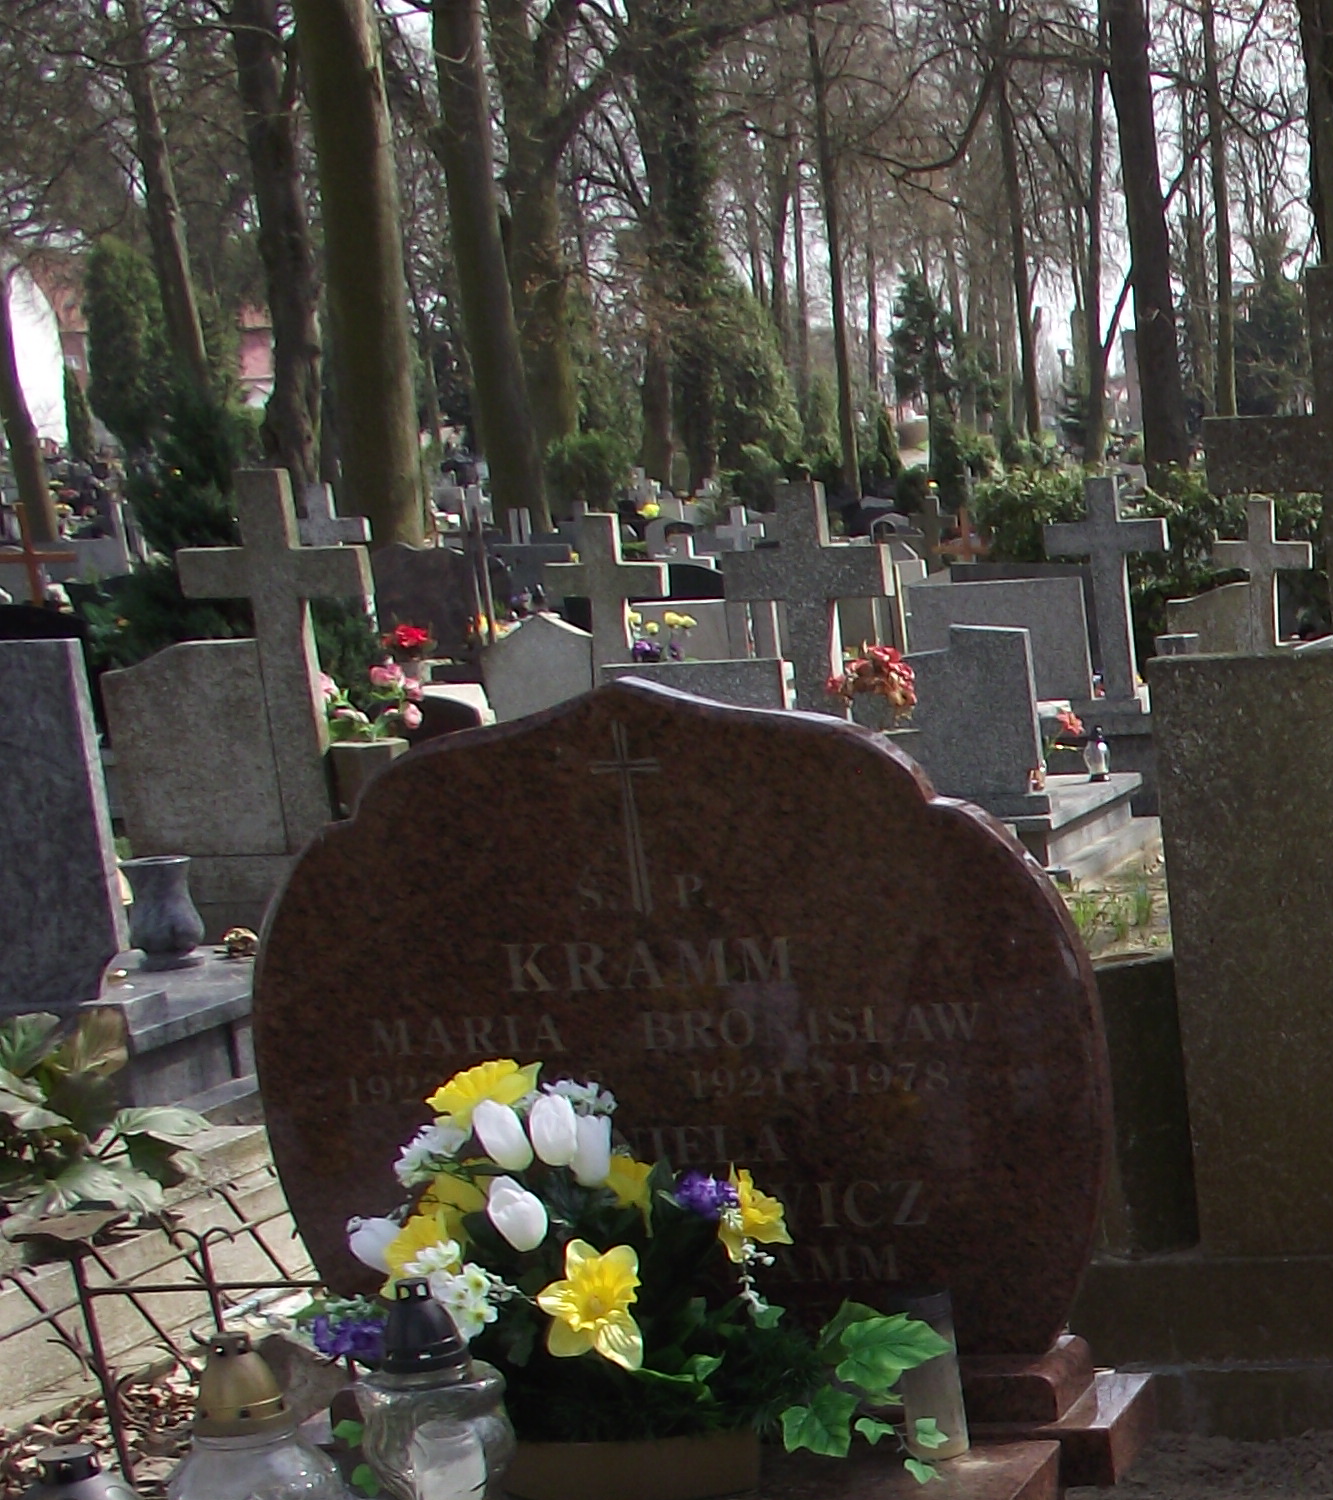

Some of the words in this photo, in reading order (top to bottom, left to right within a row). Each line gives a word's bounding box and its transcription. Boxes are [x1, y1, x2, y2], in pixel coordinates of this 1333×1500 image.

[502, 936, 796, 993] KRAMM
[370, 1013, 568, 1056] MARIA
[690, 1064, 787, 1099] 1921
[848, 1061, 951, 1094] 1978
